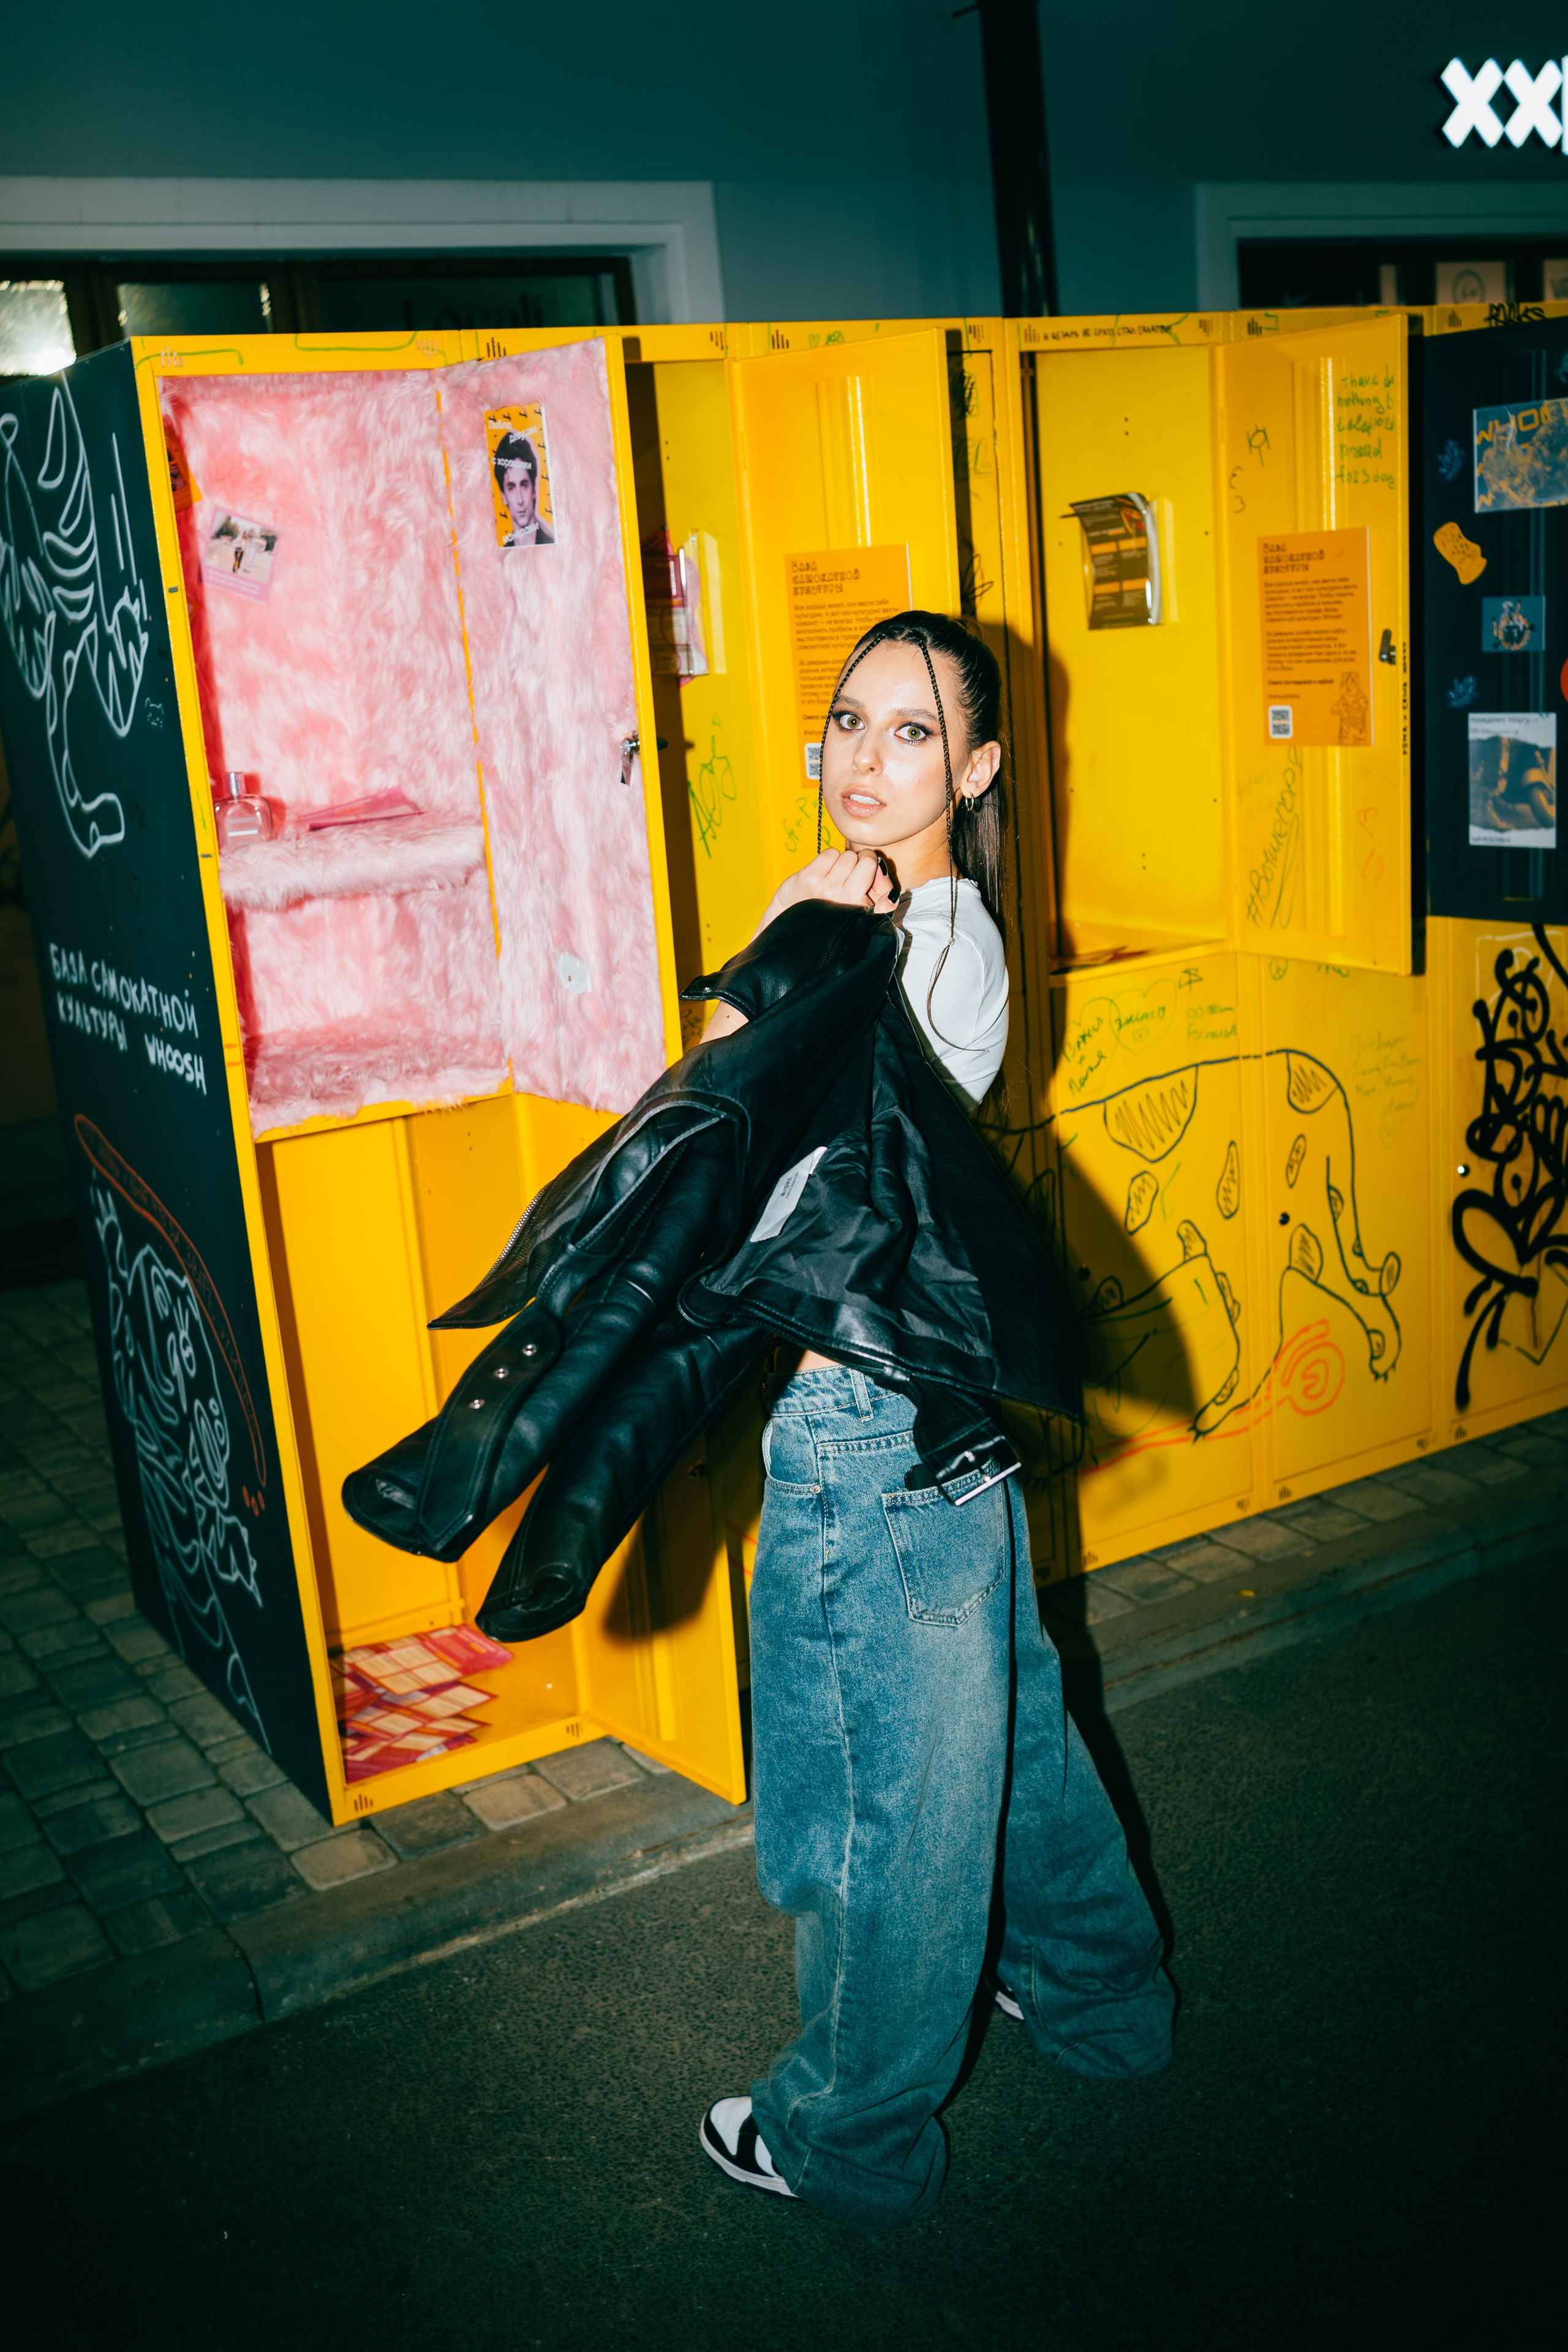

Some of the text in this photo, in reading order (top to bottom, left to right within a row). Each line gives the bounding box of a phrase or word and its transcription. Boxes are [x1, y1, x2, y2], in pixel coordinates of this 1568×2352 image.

[1082, 328, 1091, 337] НЕ
[49, 942, 199, 1039] БАЗА САМОКАТНОЙ
[56, 990, 207, 1095] КУЛЬТУРЫ WHOOSH
